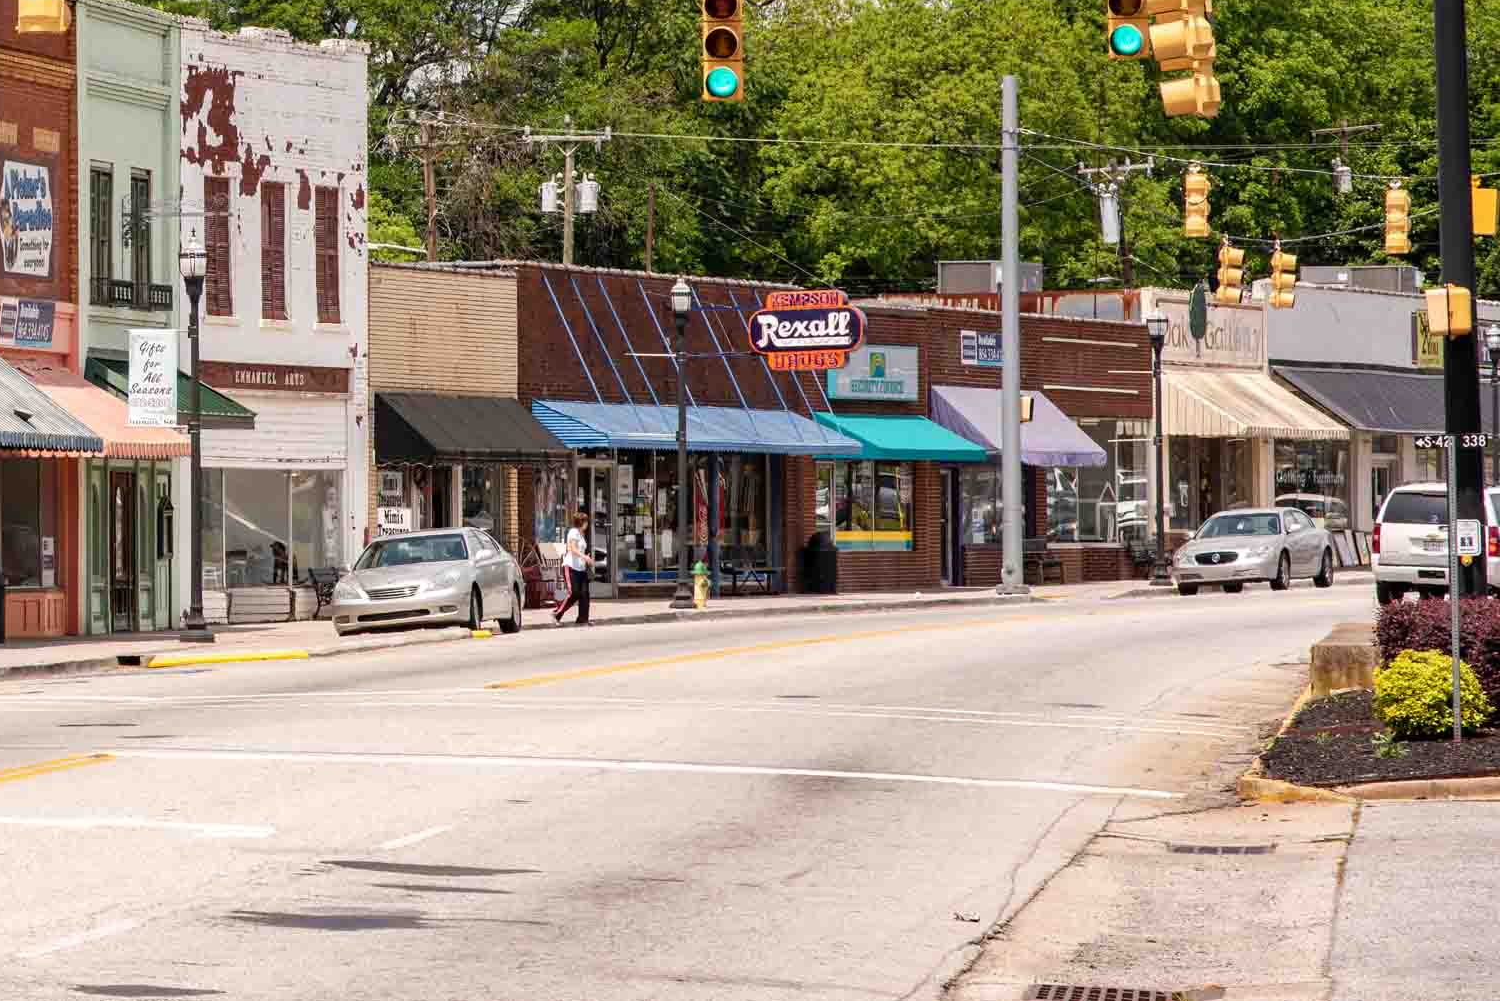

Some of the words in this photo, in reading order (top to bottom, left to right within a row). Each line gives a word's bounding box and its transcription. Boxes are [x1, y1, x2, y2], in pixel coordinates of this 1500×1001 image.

[771, 292, 838, 306] KEMPSON
[756, 312, 852, 349] Rexall
[140, 341, 166, 357] Gifts
[143, 359, 161, 373] for
[773, 352, 838, 369] DRUGS
[143, 372, 163, 383] All
[235, 370, 276, 384] EMMANUEL
[284, 373, 305, 385] ARTS
[132, 382, 172, 395] Seasons
